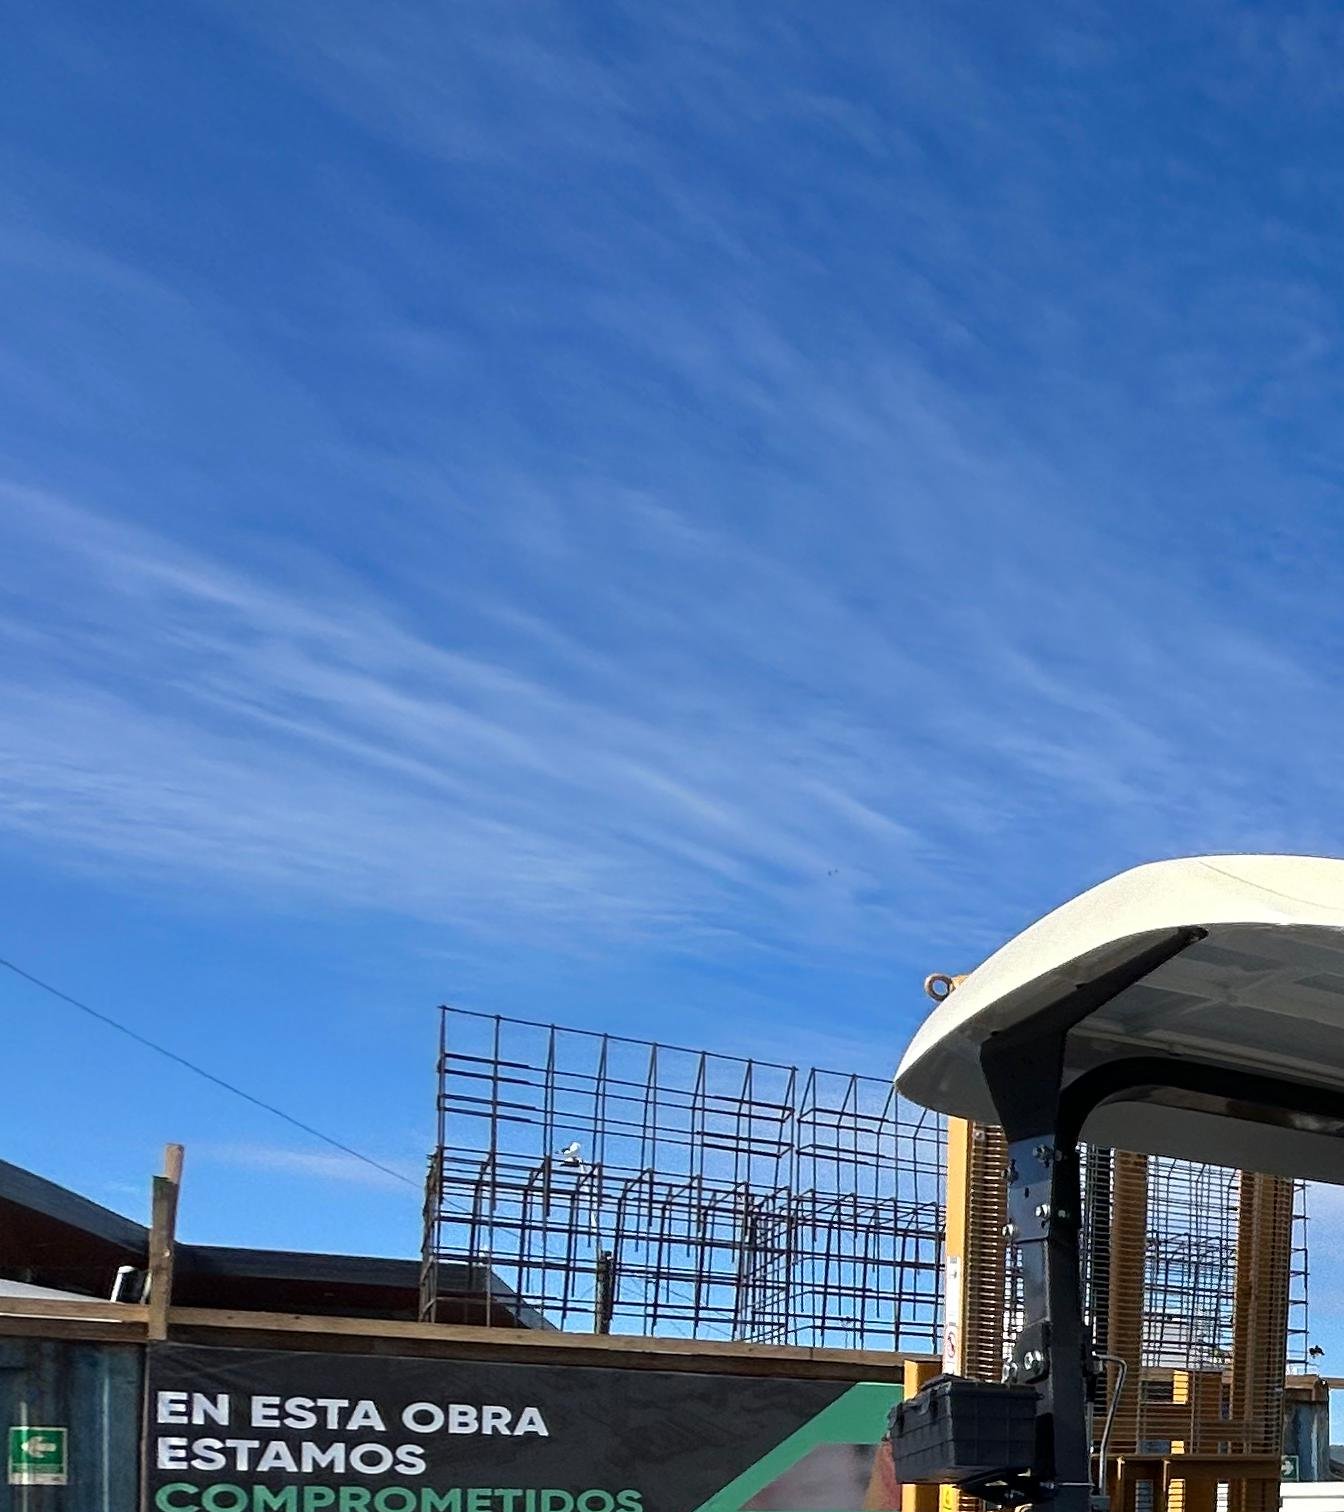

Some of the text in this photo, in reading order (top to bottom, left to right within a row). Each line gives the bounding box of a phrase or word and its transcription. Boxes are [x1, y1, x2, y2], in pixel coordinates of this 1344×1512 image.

[157, 1390, 550, 1436] EN ESTA OBRA
[157, 1436, 427, 1476] ESTAMOS
